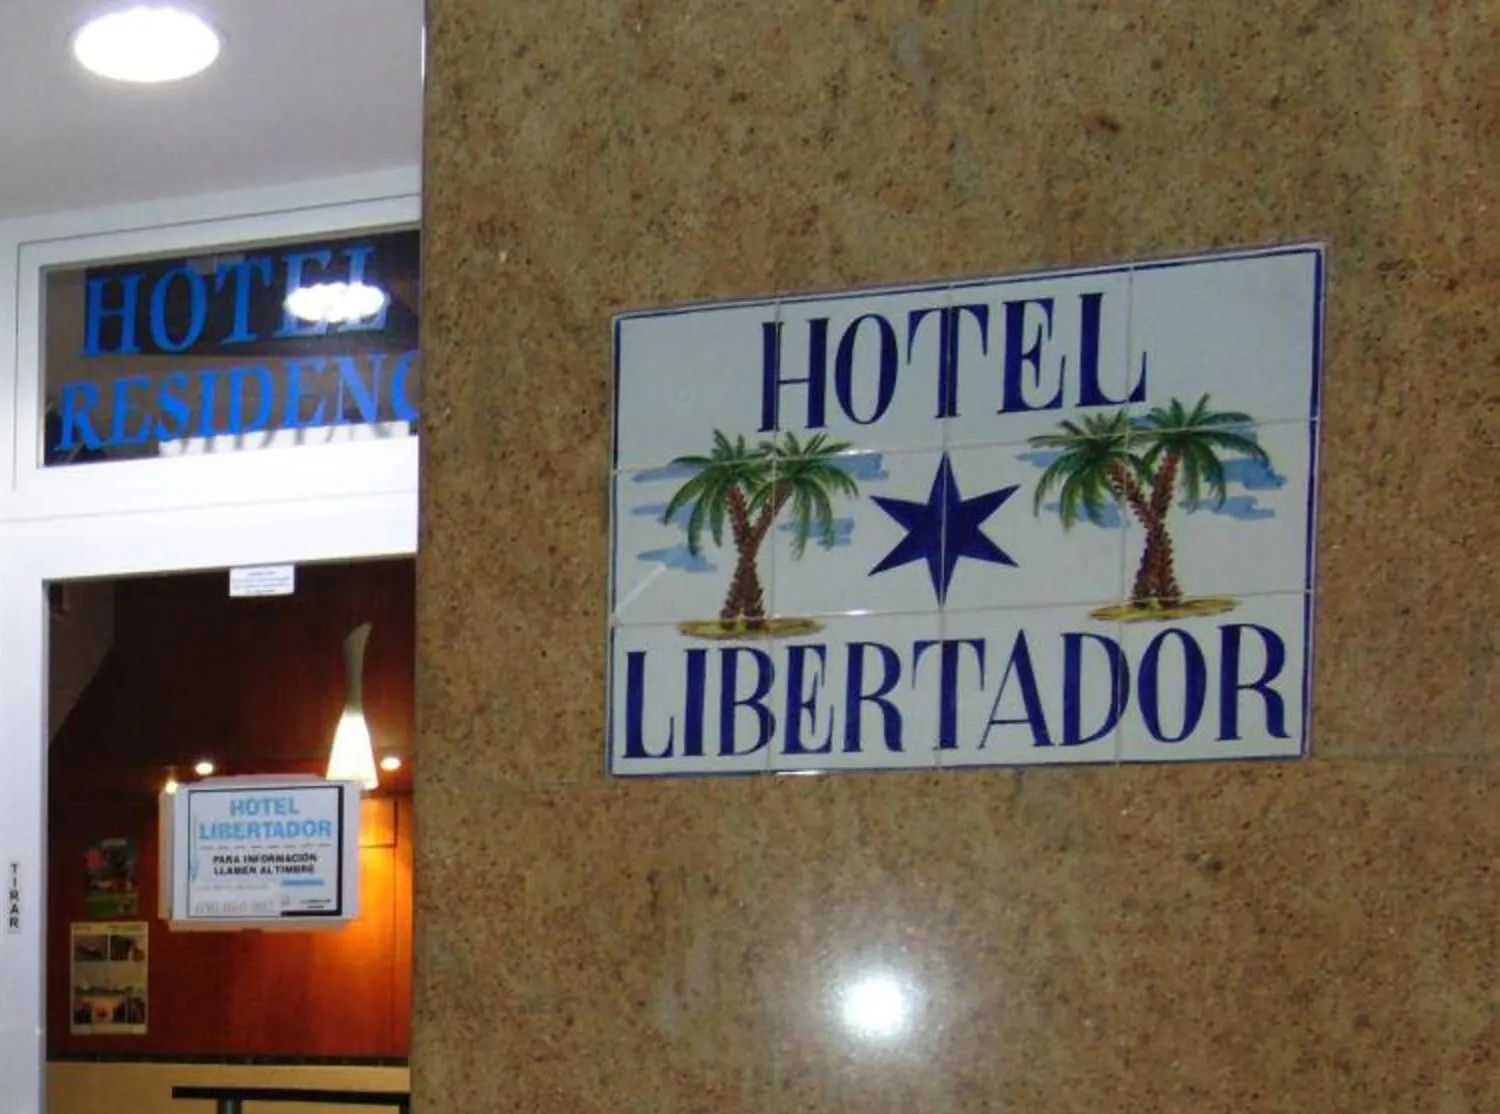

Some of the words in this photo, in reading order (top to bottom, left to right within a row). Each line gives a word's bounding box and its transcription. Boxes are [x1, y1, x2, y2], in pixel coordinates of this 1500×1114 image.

[79, 243, 390, 358] HOTEL
[757, 291, 1148, 433] HOTEL
[620, 622, 1293, 760] LIBERTADOR
[230, 796, 301, 817] HOTEL
[199, 819, 332, 841] LIBERTADOR
[212, 854, 241, 865] PARA
[213, 865, 257, 876] LLAMEN
[260, 865, 273, 875] AL
[274, 864, 315, 875] TIMBRE
[9, 863, 20, 929] TIRAR
